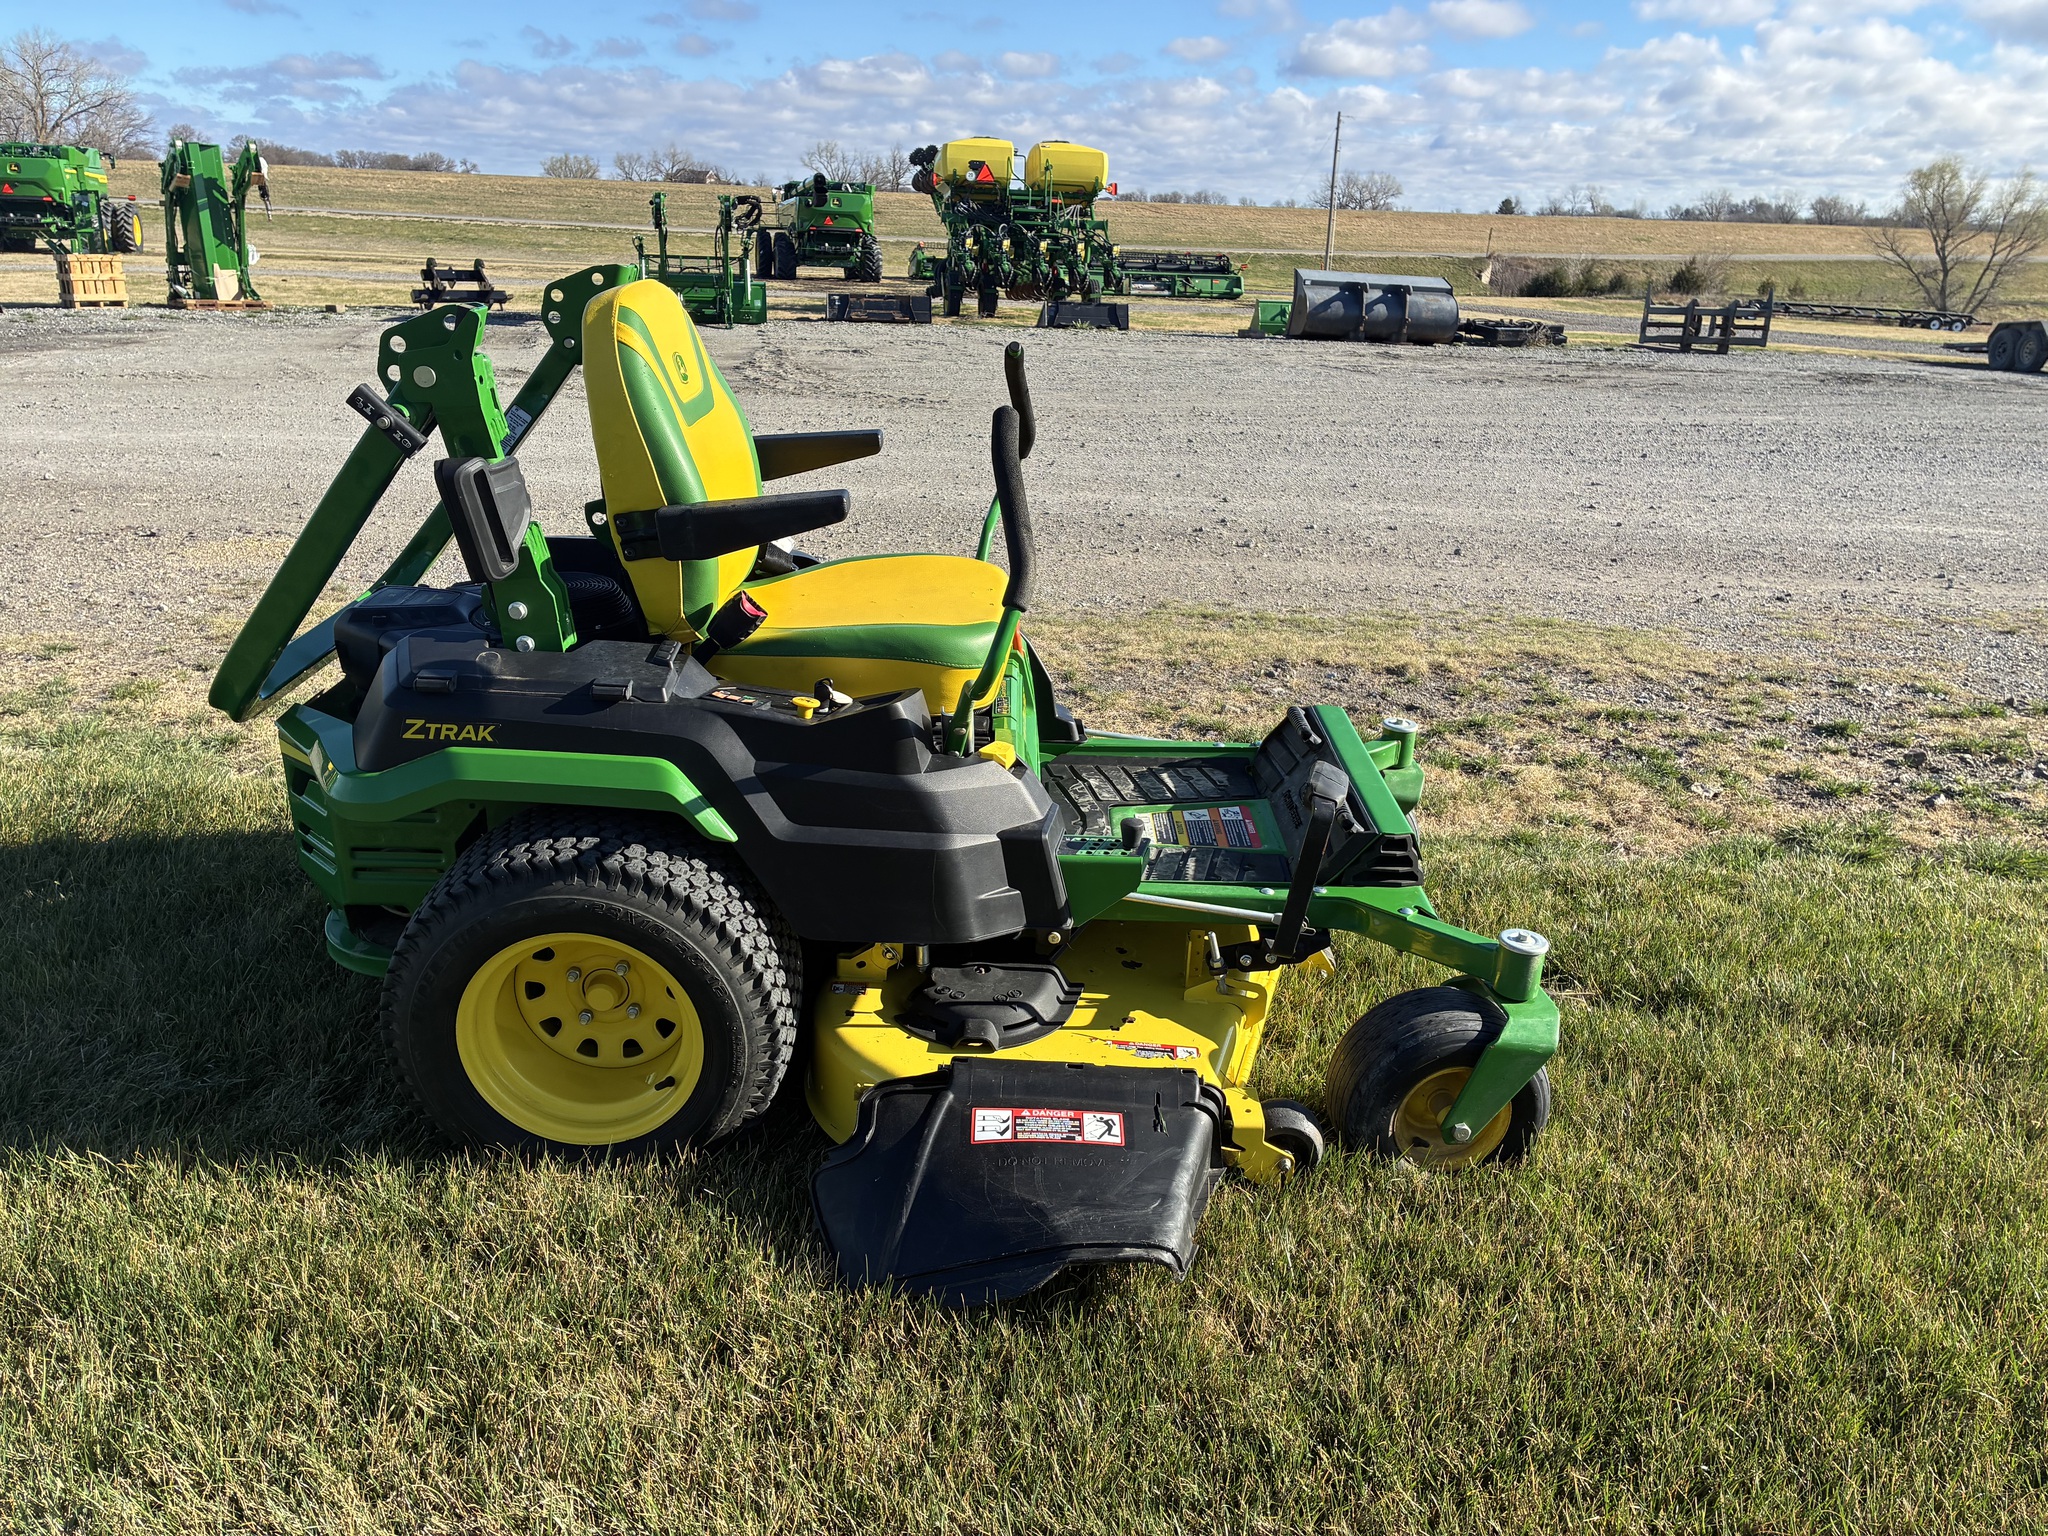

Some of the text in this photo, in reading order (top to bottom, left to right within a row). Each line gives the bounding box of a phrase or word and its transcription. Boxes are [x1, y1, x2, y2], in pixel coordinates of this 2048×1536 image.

[402, 718, 496, 742] ZTRAK
[1032, 1109, 1075, 1117] DANGER
[998, 1157, 1018, 1167] DO
[1021, 1156, 1048, 1167] NOT
